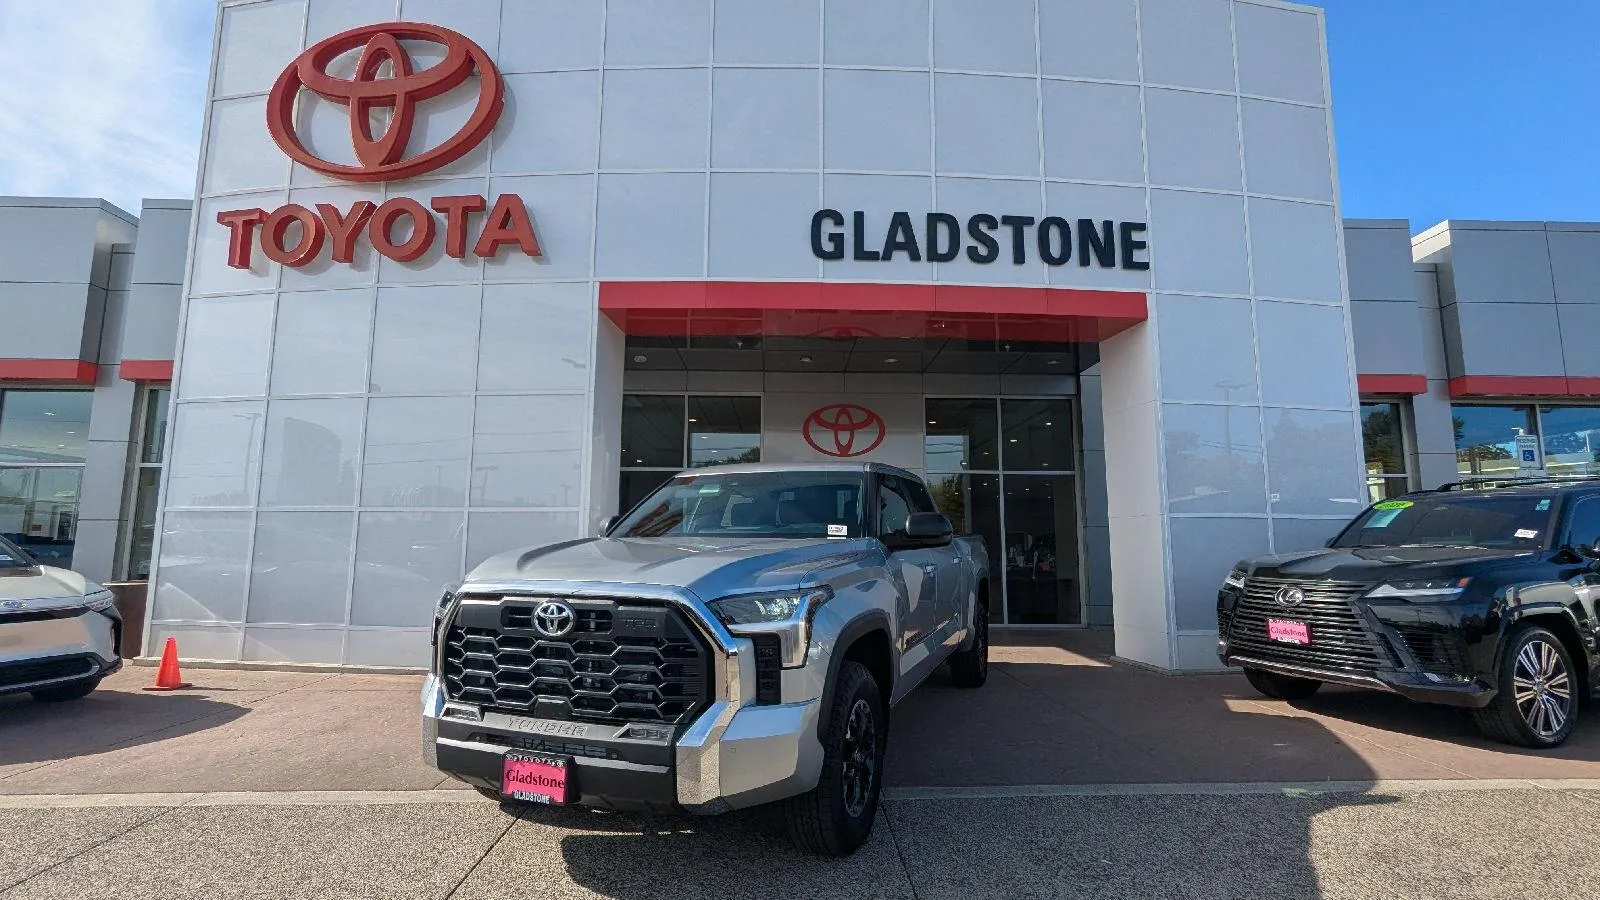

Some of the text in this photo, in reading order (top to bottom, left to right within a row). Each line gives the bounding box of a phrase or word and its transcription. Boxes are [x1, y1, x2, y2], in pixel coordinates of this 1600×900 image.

[217, 193, 542, 269] TOYOTA
[811, 209, 1150, 270] GLADSTONE
[506, 769, 565, 789] Gladstone
[514, 789, 550, 804] GLADSTONE
